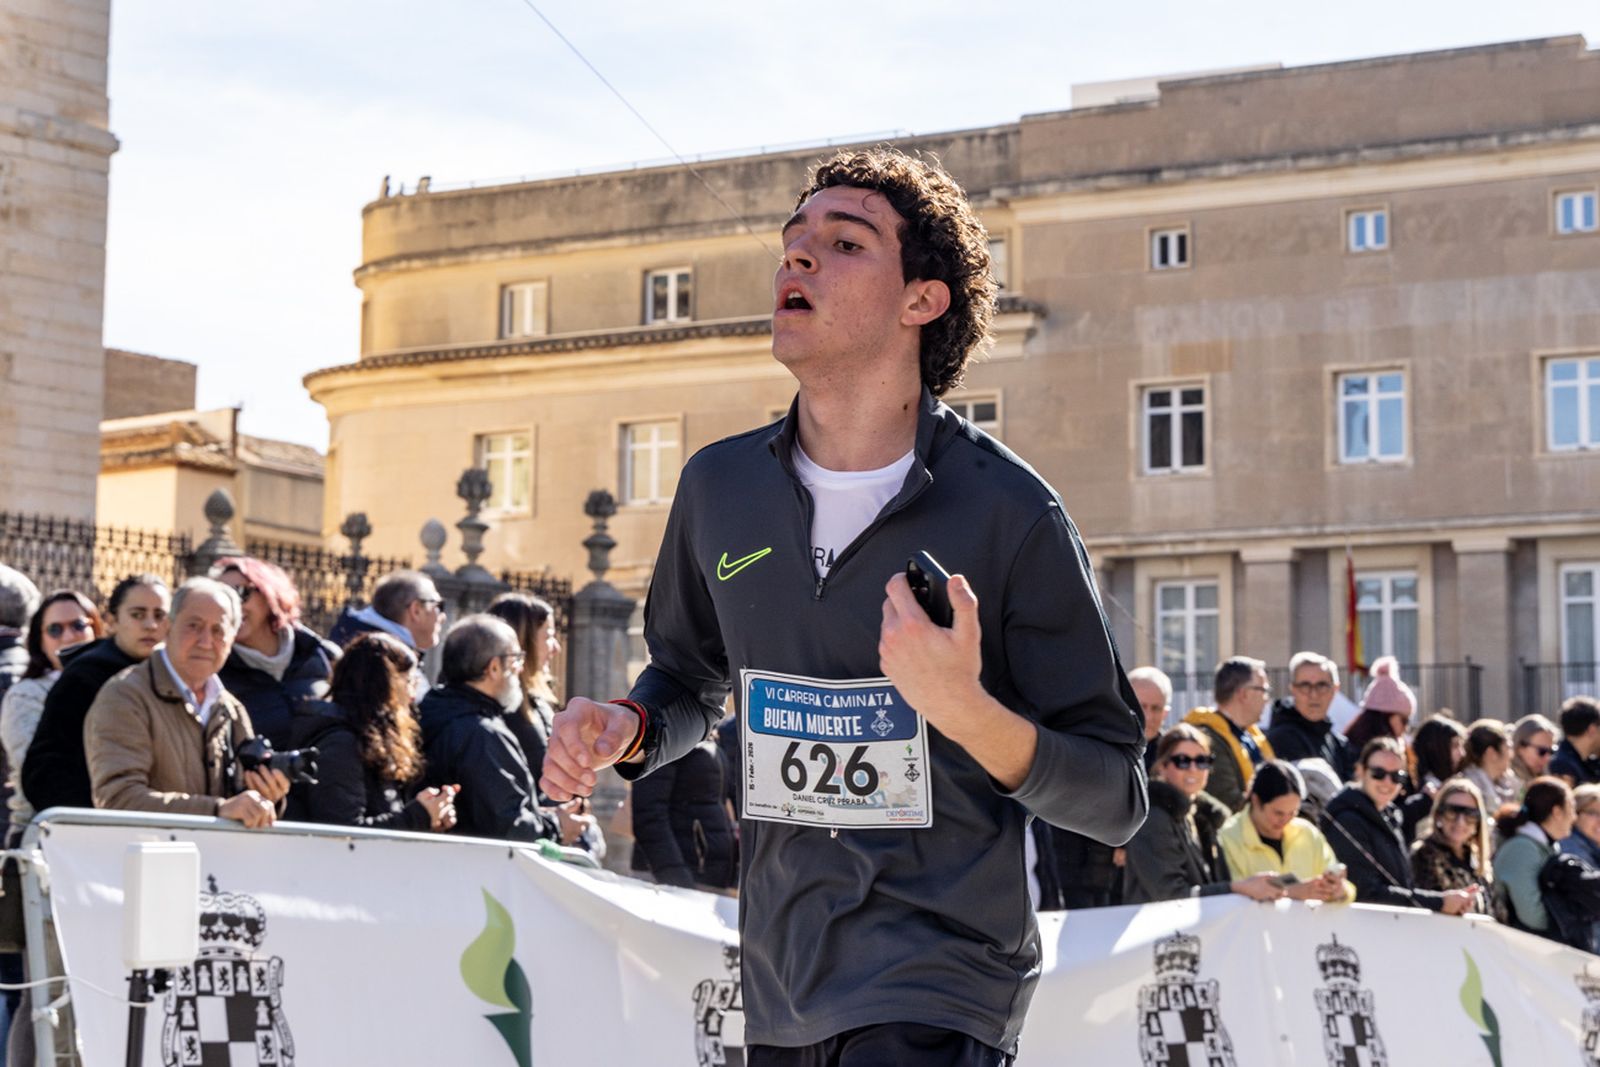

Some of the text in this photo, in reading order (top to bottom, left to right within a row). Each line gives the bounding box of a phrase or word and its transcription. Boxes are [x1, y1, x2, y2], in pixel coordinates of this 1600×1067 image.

[765, 687, 894, 709] VI CARRERA CAMINATA
[764, 707, 863, 736] BUENA MUERTE
[781, 741, 879, 797] 626
[792, 793, 816, 803] DANIEL
[817, 796, 836, 805] CRUZ
